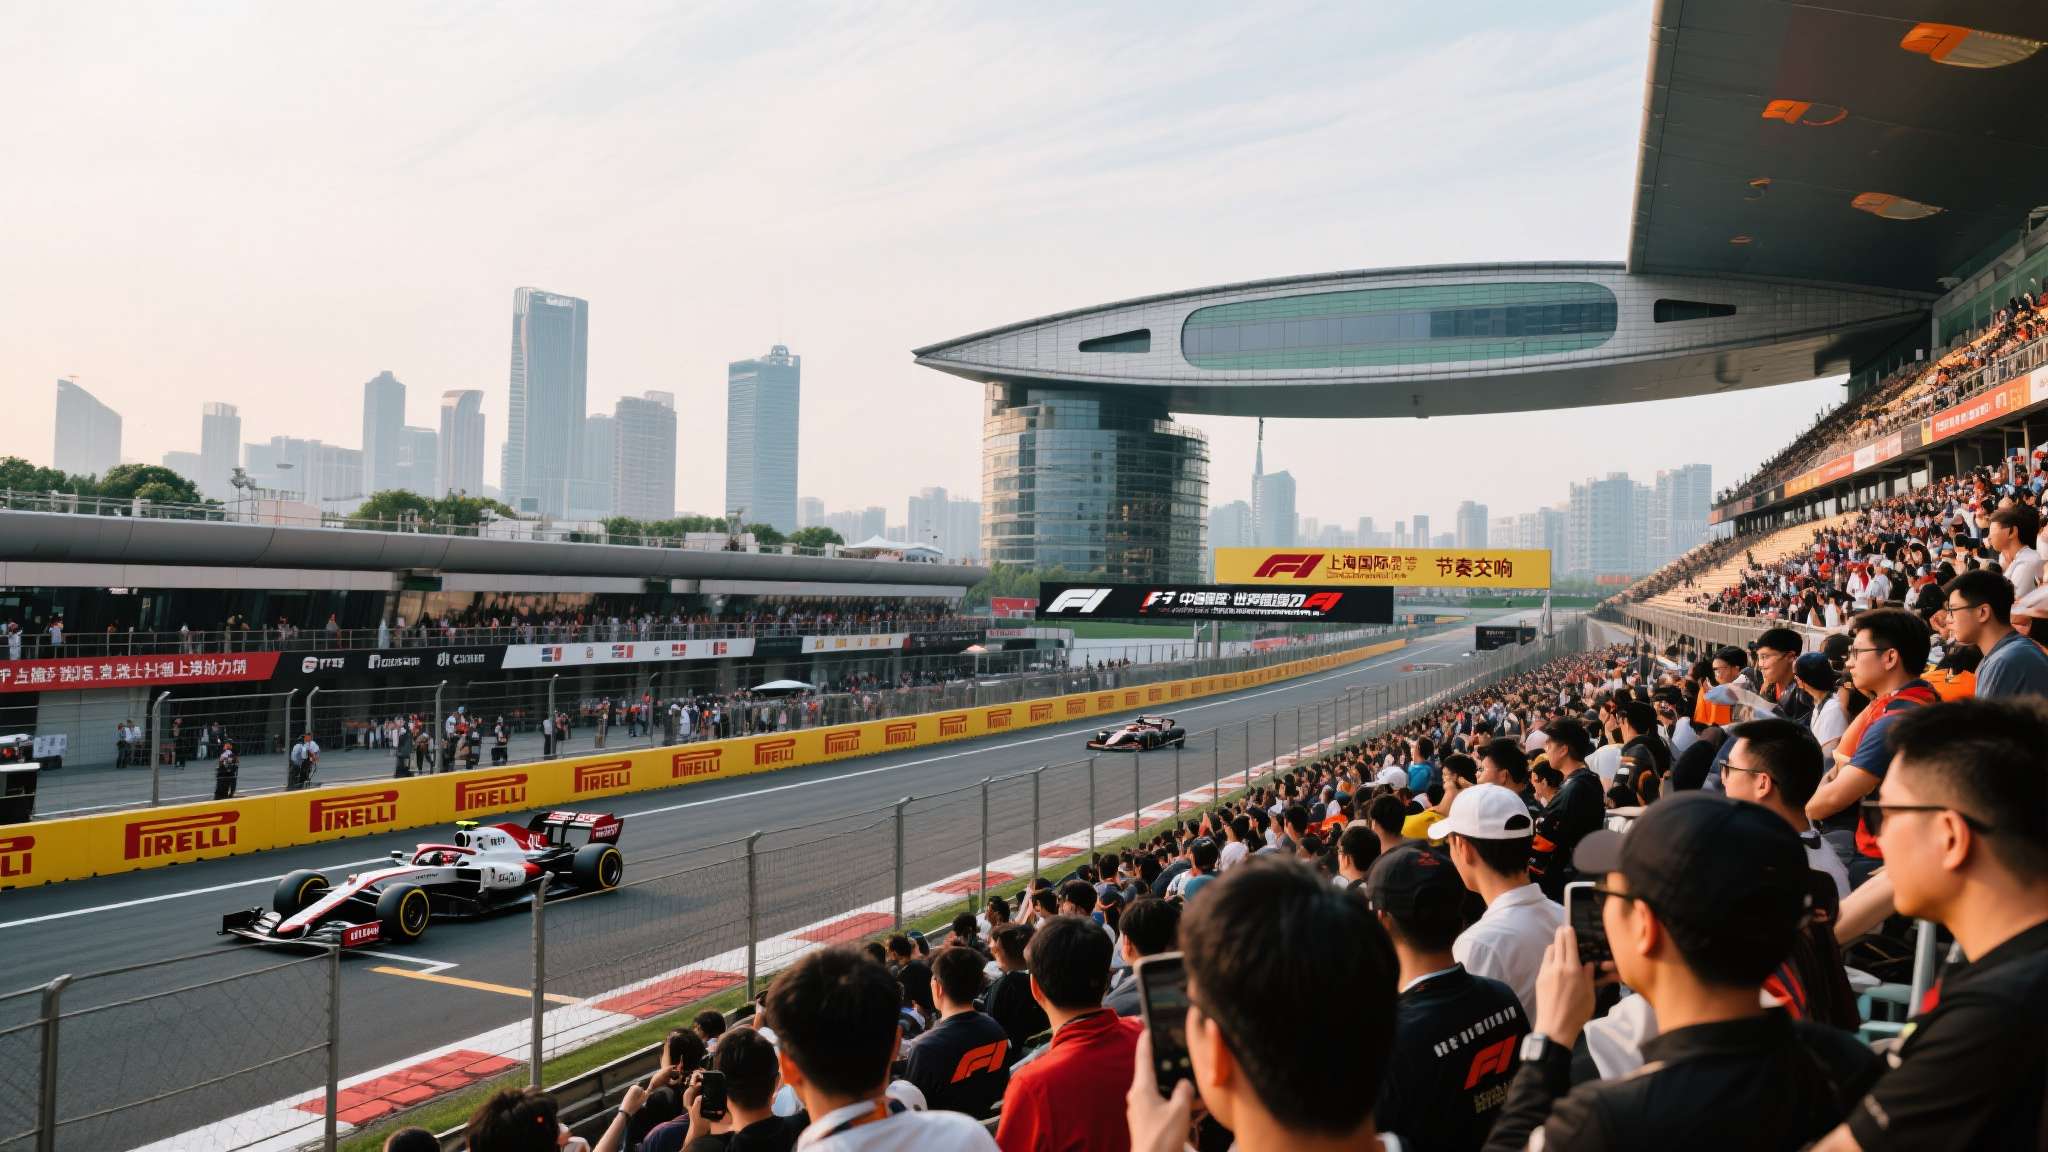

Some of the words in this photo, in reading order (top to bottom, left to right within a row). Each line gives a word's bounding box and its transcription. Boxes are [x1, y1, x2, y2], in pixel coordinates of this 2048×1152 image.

[1253, 554, 1325, 578] F1
[1435, 556, 1513, 579] 节奏交响
[1046, 588, 1113, 613] F1
[309, 790, 399, 833] PIRELLI
[124, 810, 241, 860] PIRELLI
[950, 1039, 1008, 1084] F1
[1463, 1035, 1518, 1090] F1
